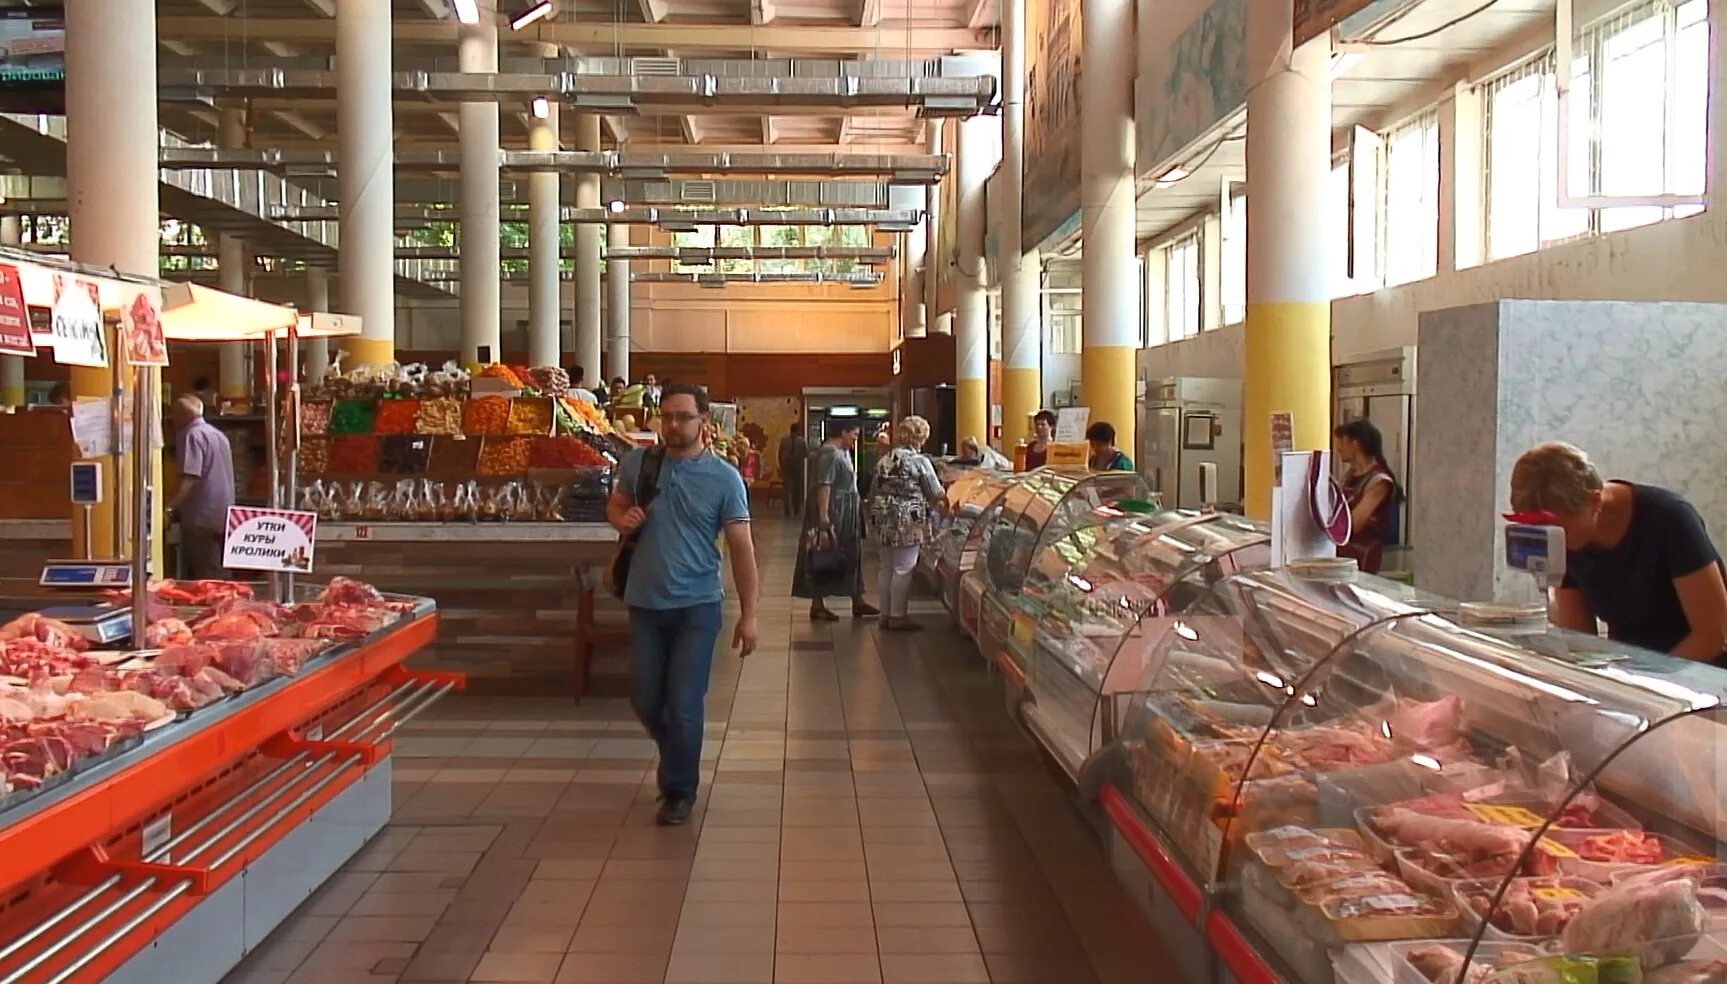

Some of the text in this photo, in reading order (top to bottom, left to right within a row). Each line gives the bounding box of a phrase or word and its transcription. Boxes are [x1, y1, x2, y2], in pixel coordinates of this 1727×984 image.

[257, 521, 286, 532] УТКИ
[243, 534, 276, 544] КУРЫ
[230, 546, 286, 558] КРОЛИКИ
